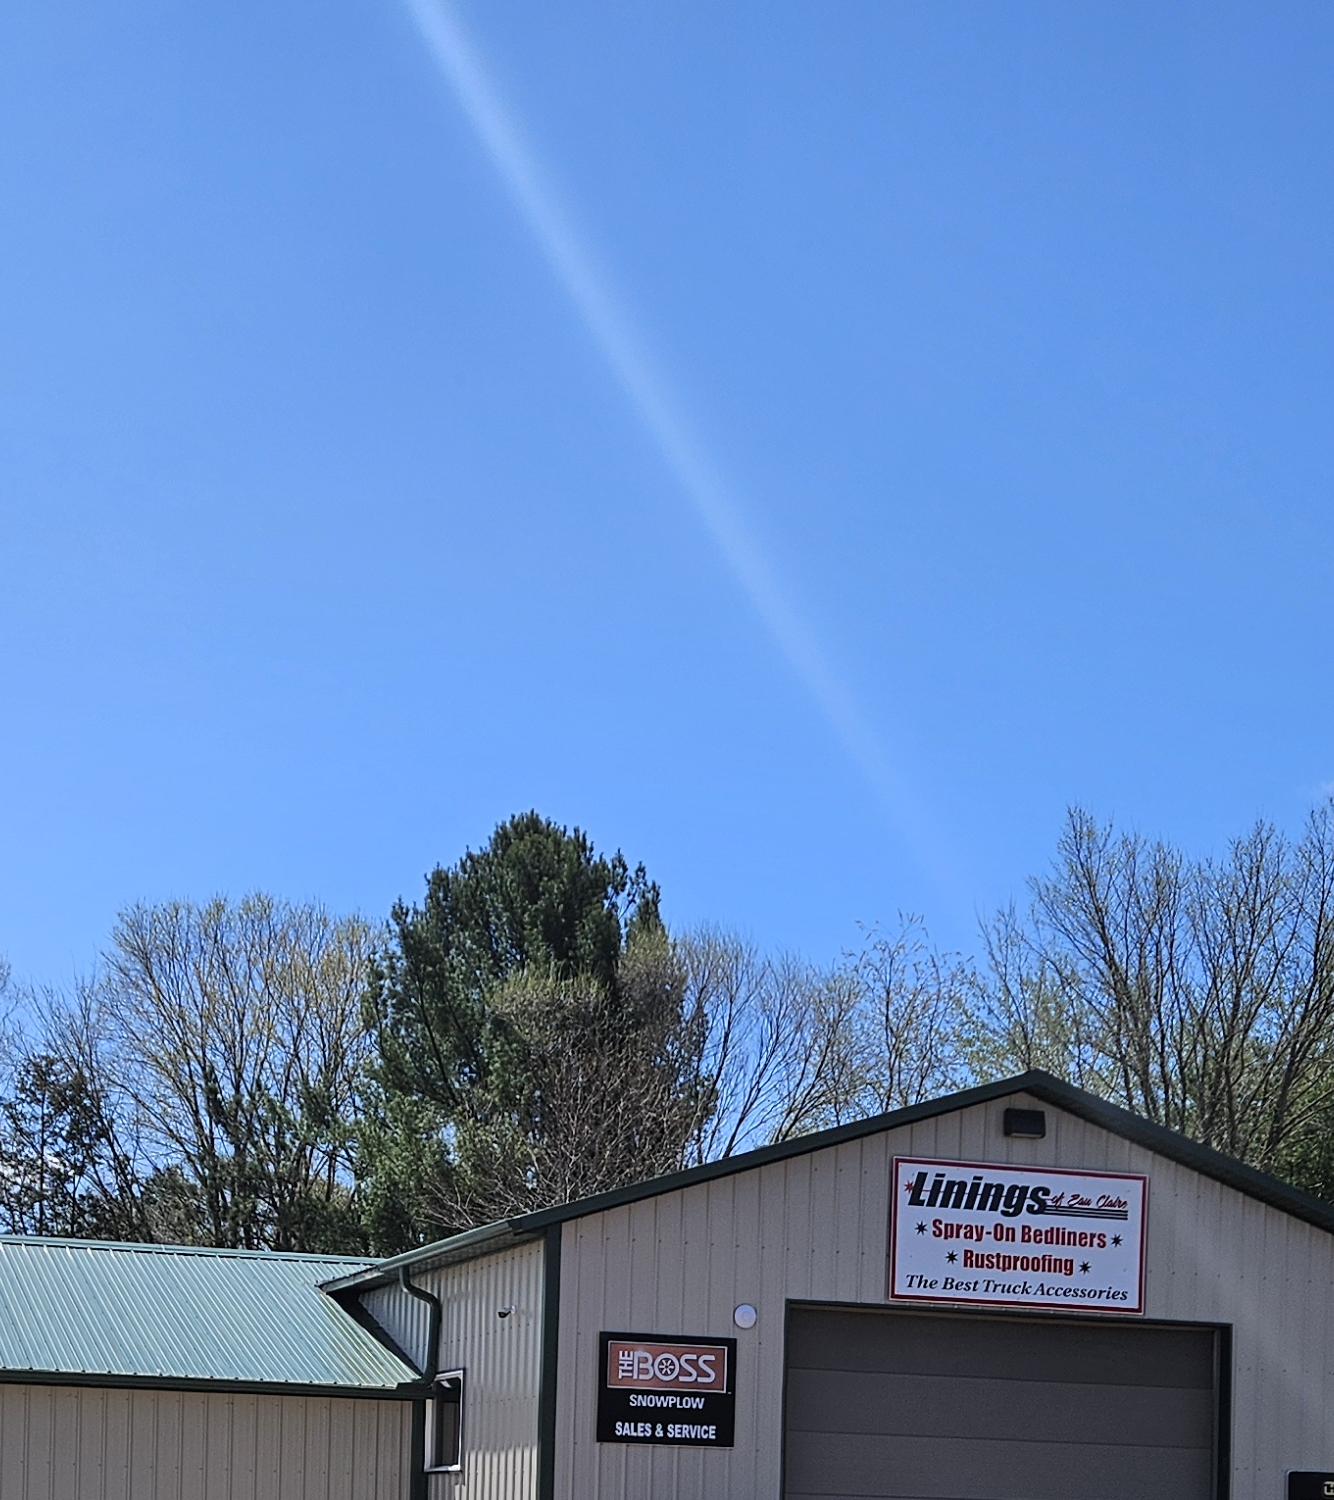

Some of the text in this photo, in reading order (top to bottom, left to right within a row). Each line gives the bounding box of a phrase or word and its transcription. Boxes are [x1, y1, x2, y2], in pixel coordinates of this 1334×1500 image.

[907, 1171, 1051, 1218] Linings
[932, 1218, 1107, 1249] Spray-On Bedliners
[963, 1249, 1074, 1276] Rustproofing
[906, 1274, 1129, 1301] The Best Truck Accessories
[618, 1350, 715, 1383] THE BOSS
[629, 1394, 705, 1409] SNOWPLOW
[615, 1421, 717, 1439] SALES & SERVICE
